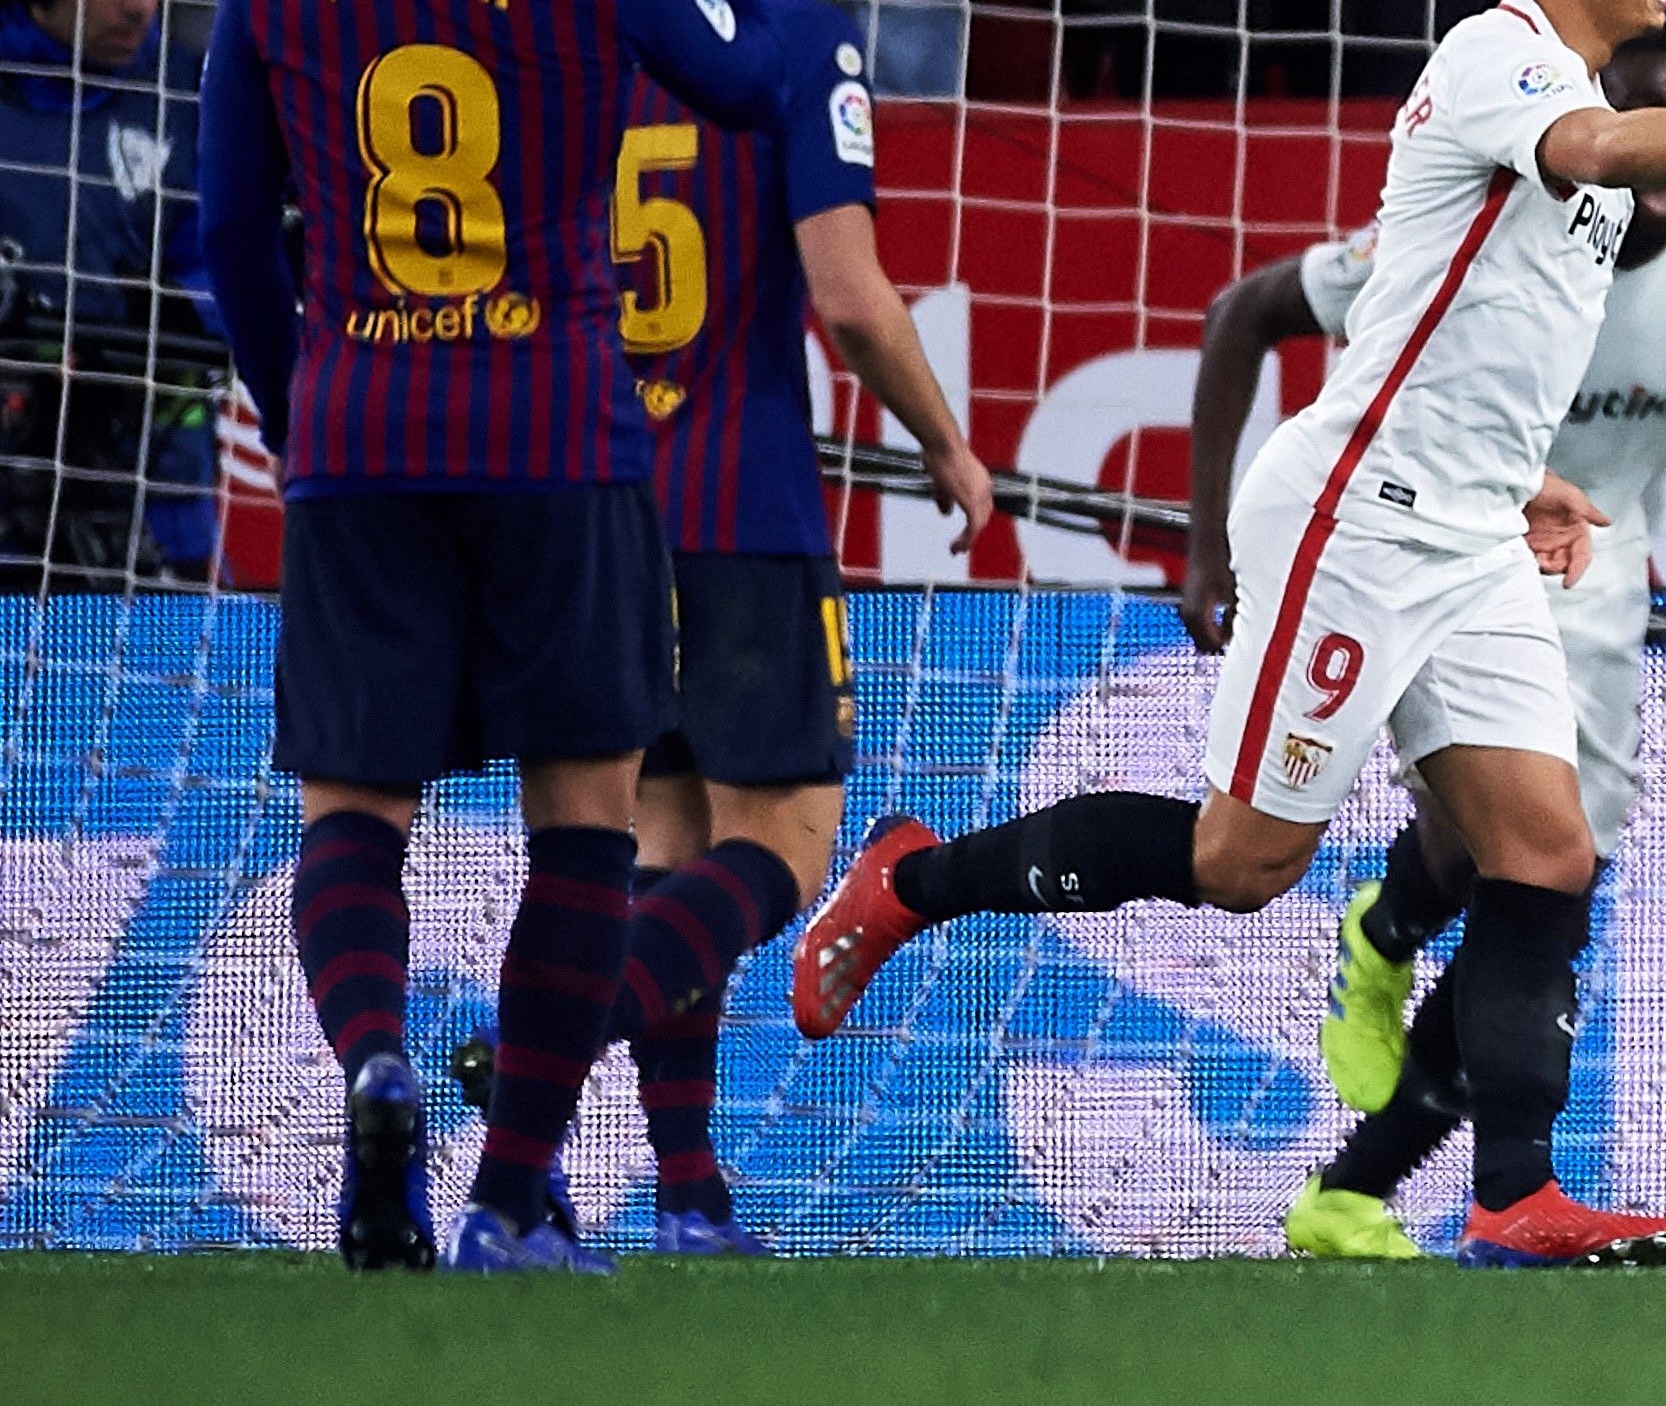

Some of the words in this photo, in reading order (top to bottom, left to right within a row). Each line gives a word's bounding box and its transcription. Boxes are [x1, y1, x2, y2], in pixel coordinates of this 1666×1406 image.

[356, 43, 508, 297] 8
[346, 295, 479, 345] unicef
[1303, 632, 1365, 722] 9
